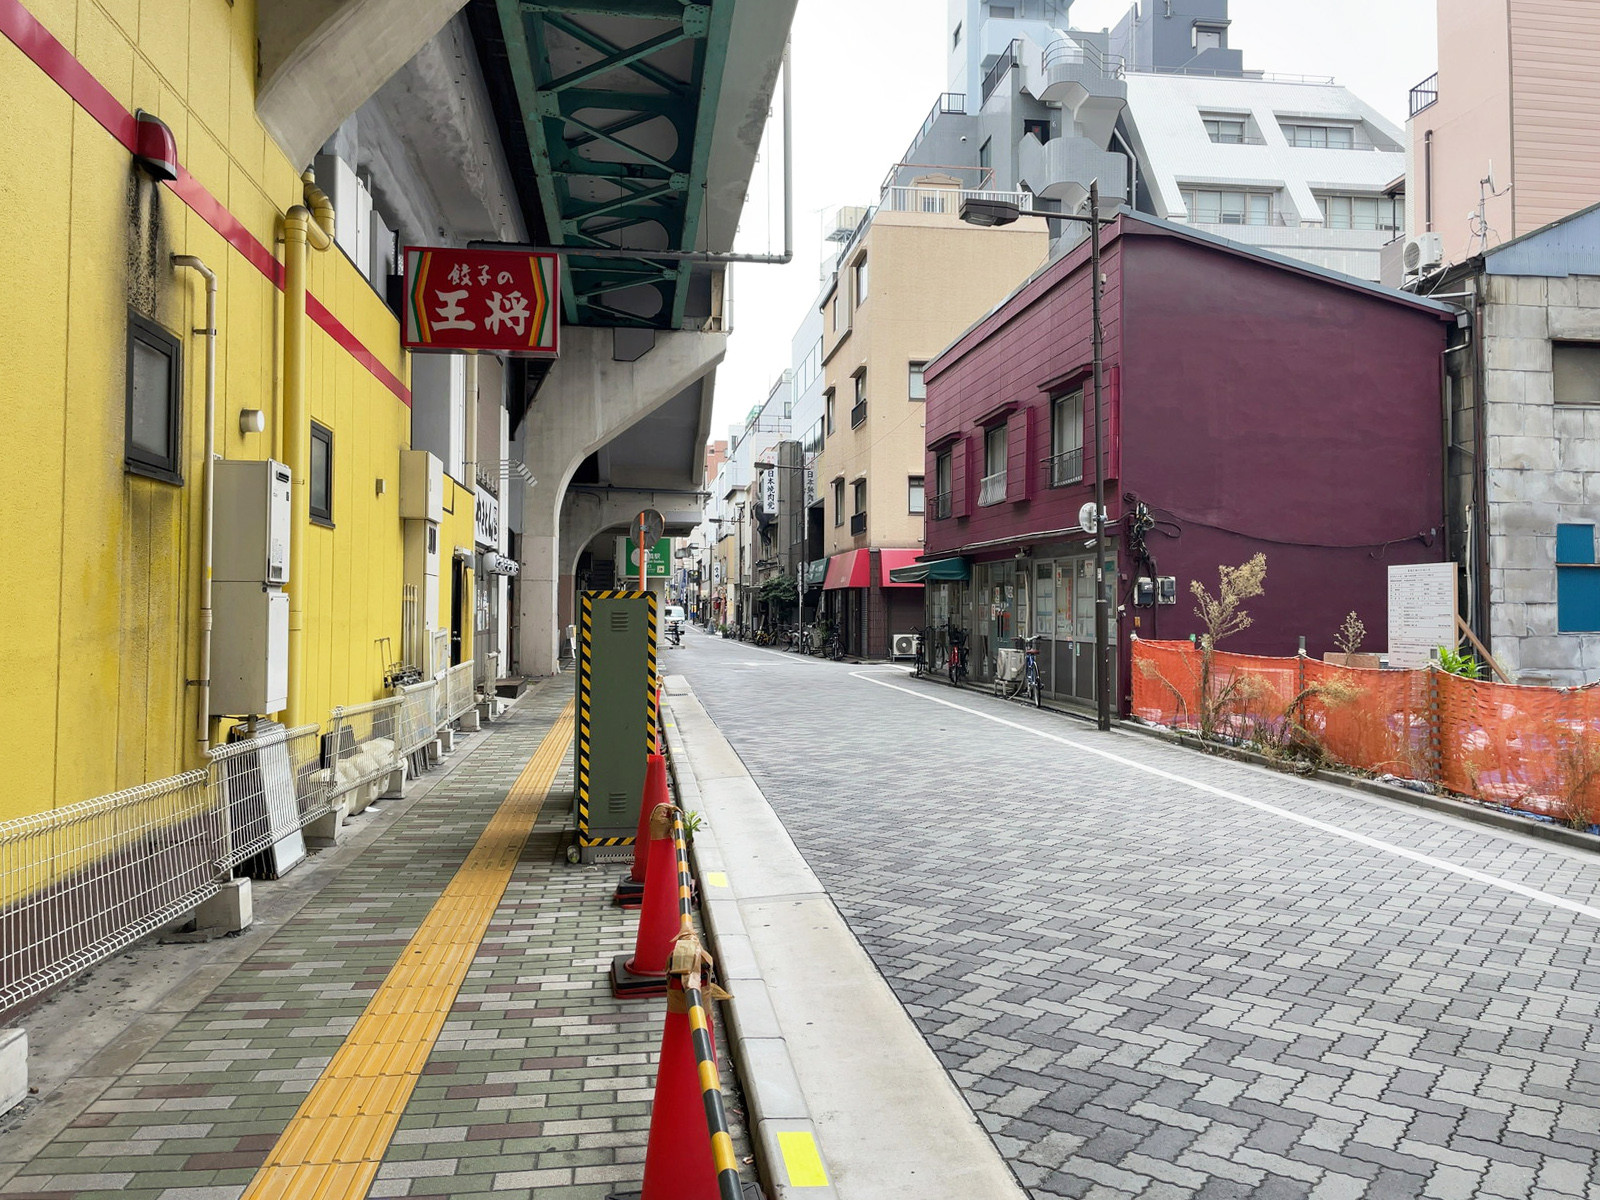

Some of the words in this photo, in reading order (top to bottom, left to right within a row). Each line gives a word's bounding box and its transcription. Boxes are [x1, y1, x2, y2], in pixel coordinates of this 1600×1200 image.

[447, 263, 514, 286] 餃子の
[430, 289, 531, 336] 王将
